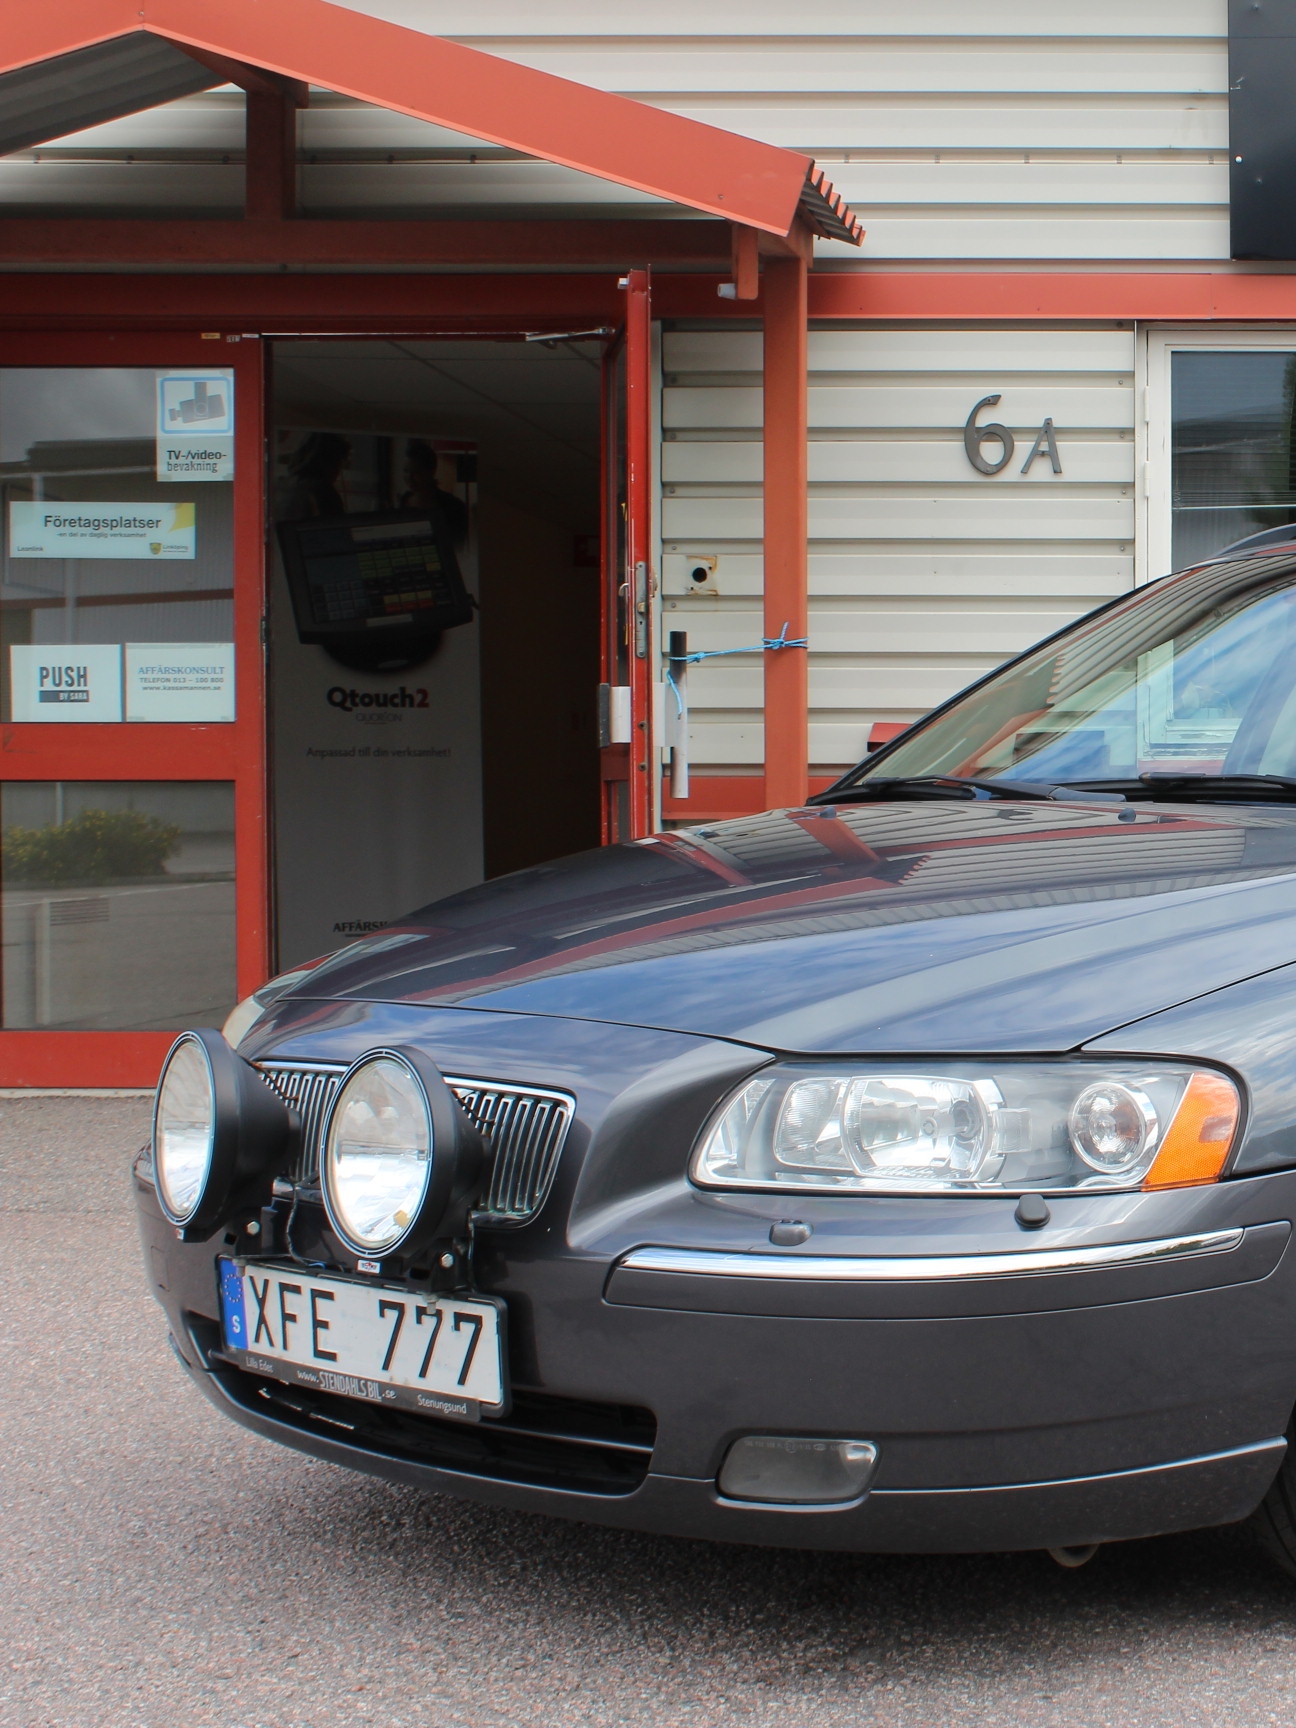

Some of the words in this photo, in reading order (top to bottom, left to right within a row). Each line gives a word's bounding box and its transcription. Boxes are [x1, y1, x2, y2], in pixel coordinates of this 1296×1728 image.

[964, 394, 1062, 475] 6A
[167, 460, 218, 473] bevakning
[44, 515, 162, 531] Företagsplatser
[39, 666, 88, 688] PUSH
[138, 664, 225, 675] AFFÄRSKONSULT
[326, 686, 430, 712] Qtouch2
[306, 747, 355, 758] Anpassad
[358, 747, 371, 757] till
[373, 747, 390, 757] din
[232, 1314, 241, 1334] S
[249, 1275, 338, 1362] XFE
[378, 1299, 483, 1386] 777
[417, 1394, 467, 1415] Stenungsund
